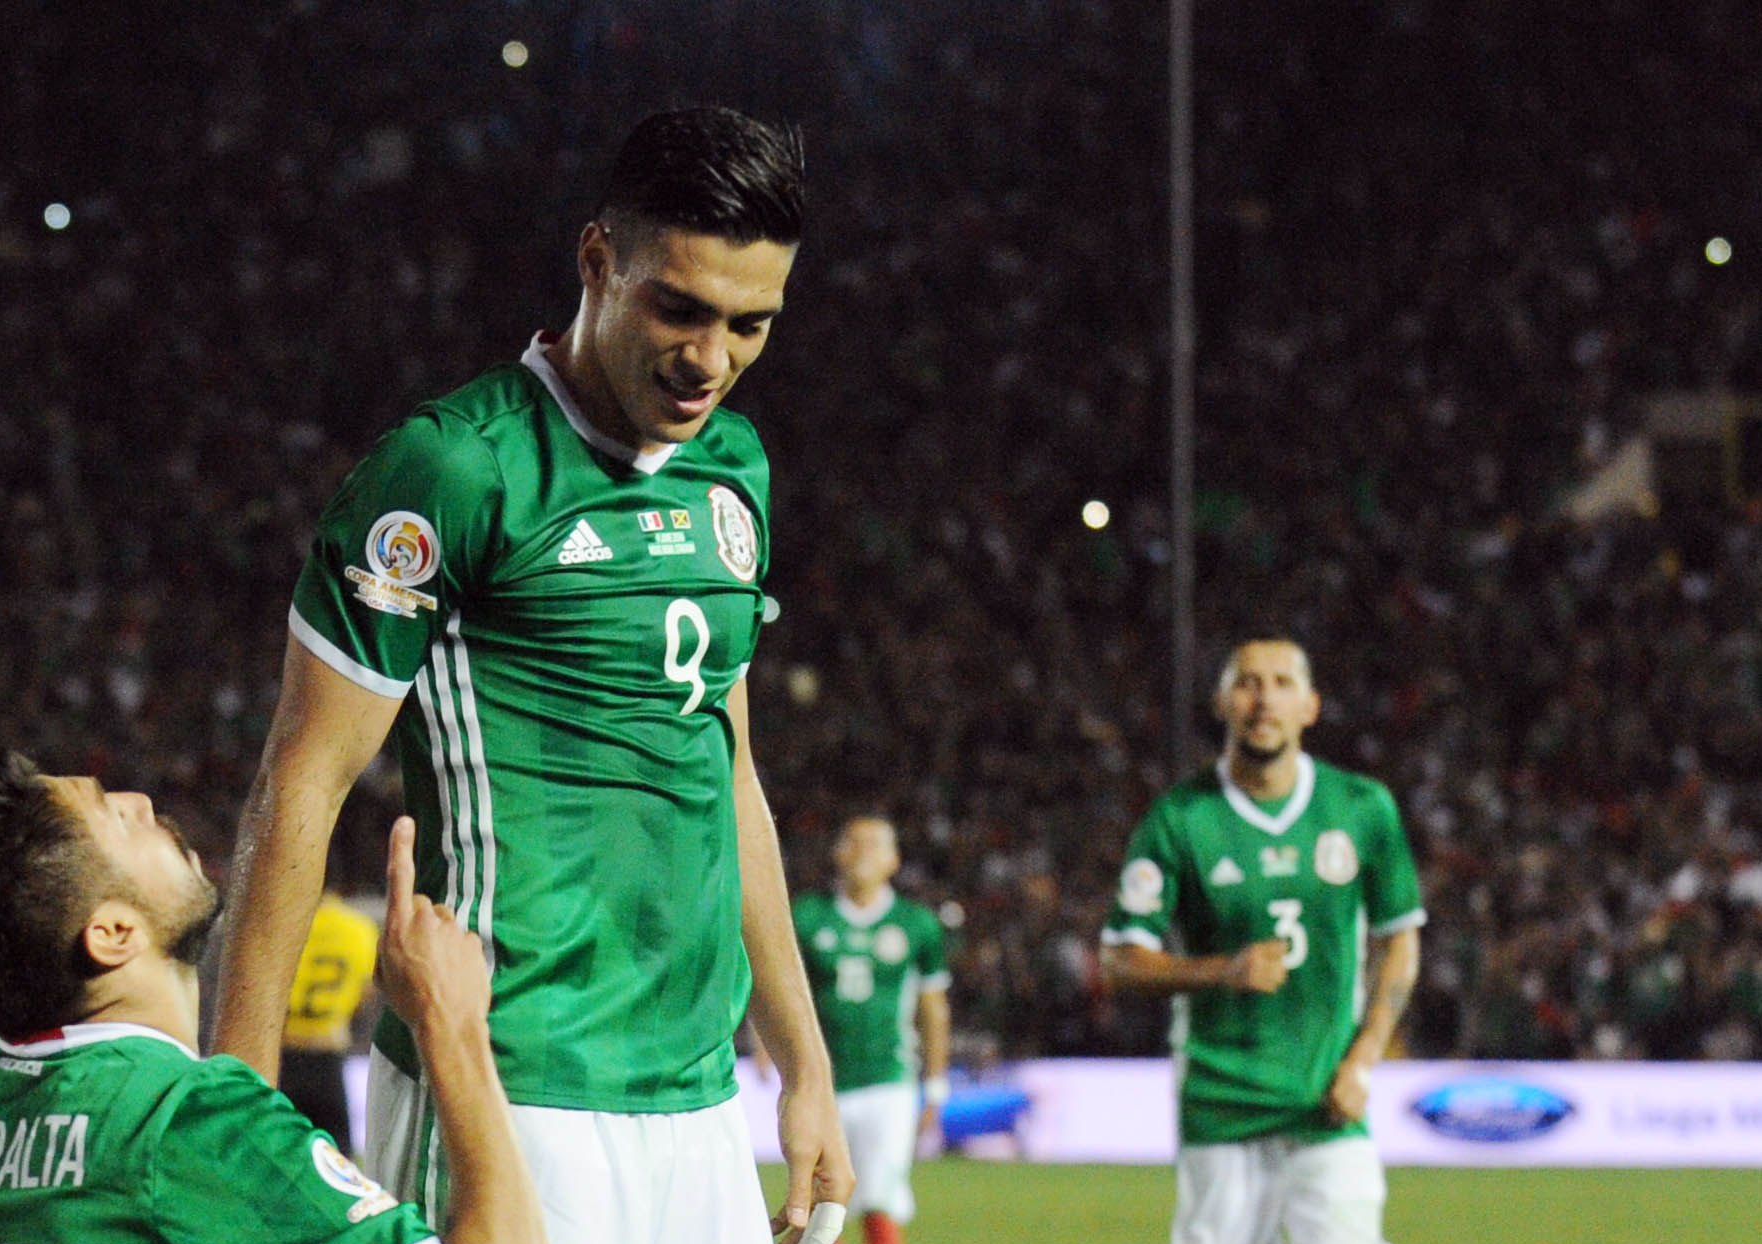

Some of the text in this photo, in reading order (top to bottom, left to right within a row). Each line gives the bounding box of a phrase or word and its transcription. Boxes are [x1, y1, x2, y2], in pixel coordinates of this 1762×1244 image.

[558, 546, 614, 565] adidas
[664, 598, 710, 717] 9
[1267, 898, 1309, 970] 3
